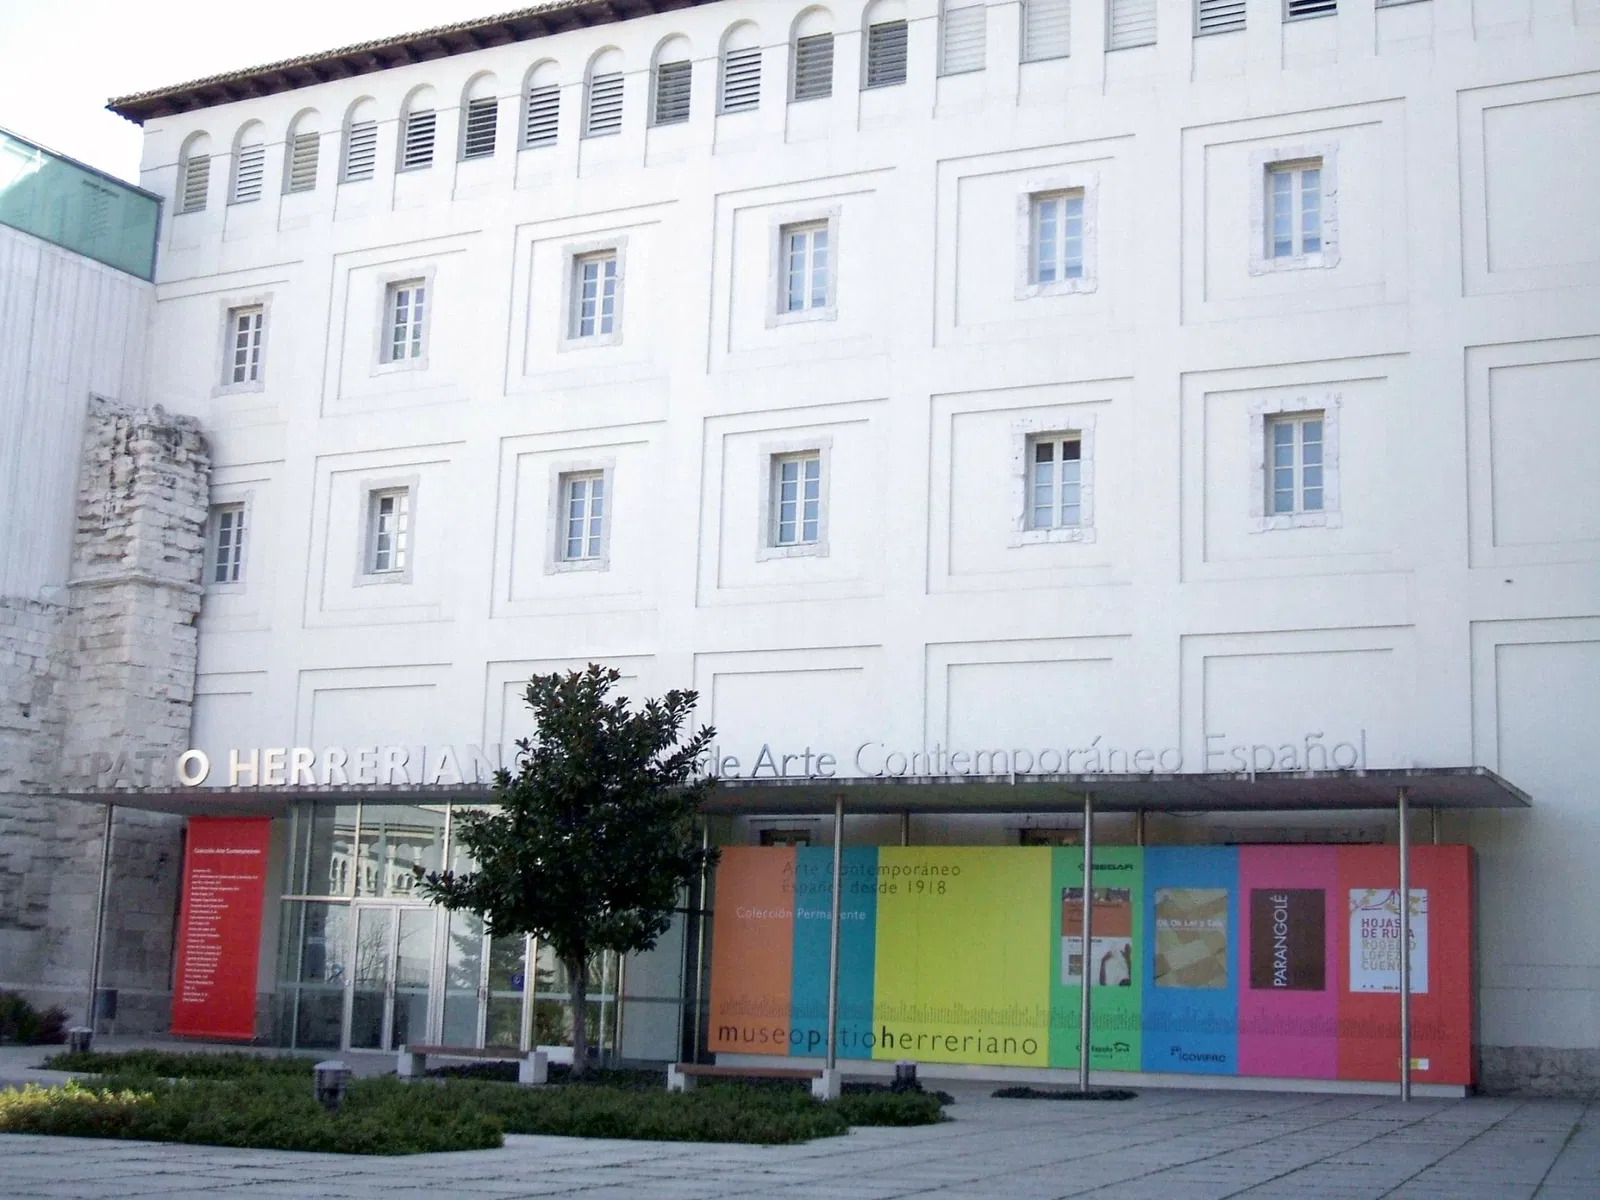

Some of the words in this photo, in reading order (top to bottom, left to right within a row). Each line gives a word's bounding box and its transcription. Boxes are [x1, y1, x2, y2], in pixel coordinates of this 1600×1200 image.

[751, 743, 836, 778] Arte
[855, 734, 1183, 785] Contemporáneo
[1201, 728, 1366, 783] Español
[782, 861, 820, 876] Arte
[849, 880, 898, 895] desde
[907, 880, 947, 895] 1918
[736, 906, 793, 919] Colección
[797, 907, 867, 921] Permaente
[1361, 918, 1402, 928] HOJAS
[1269, 894, 1288, 987] PARANGOLÉ
[1361, 928, 1378, 939] DE
[1382, 928, 1415, 939] RUA
[717, 1023, 1039, 1057] museoptioherreriano
